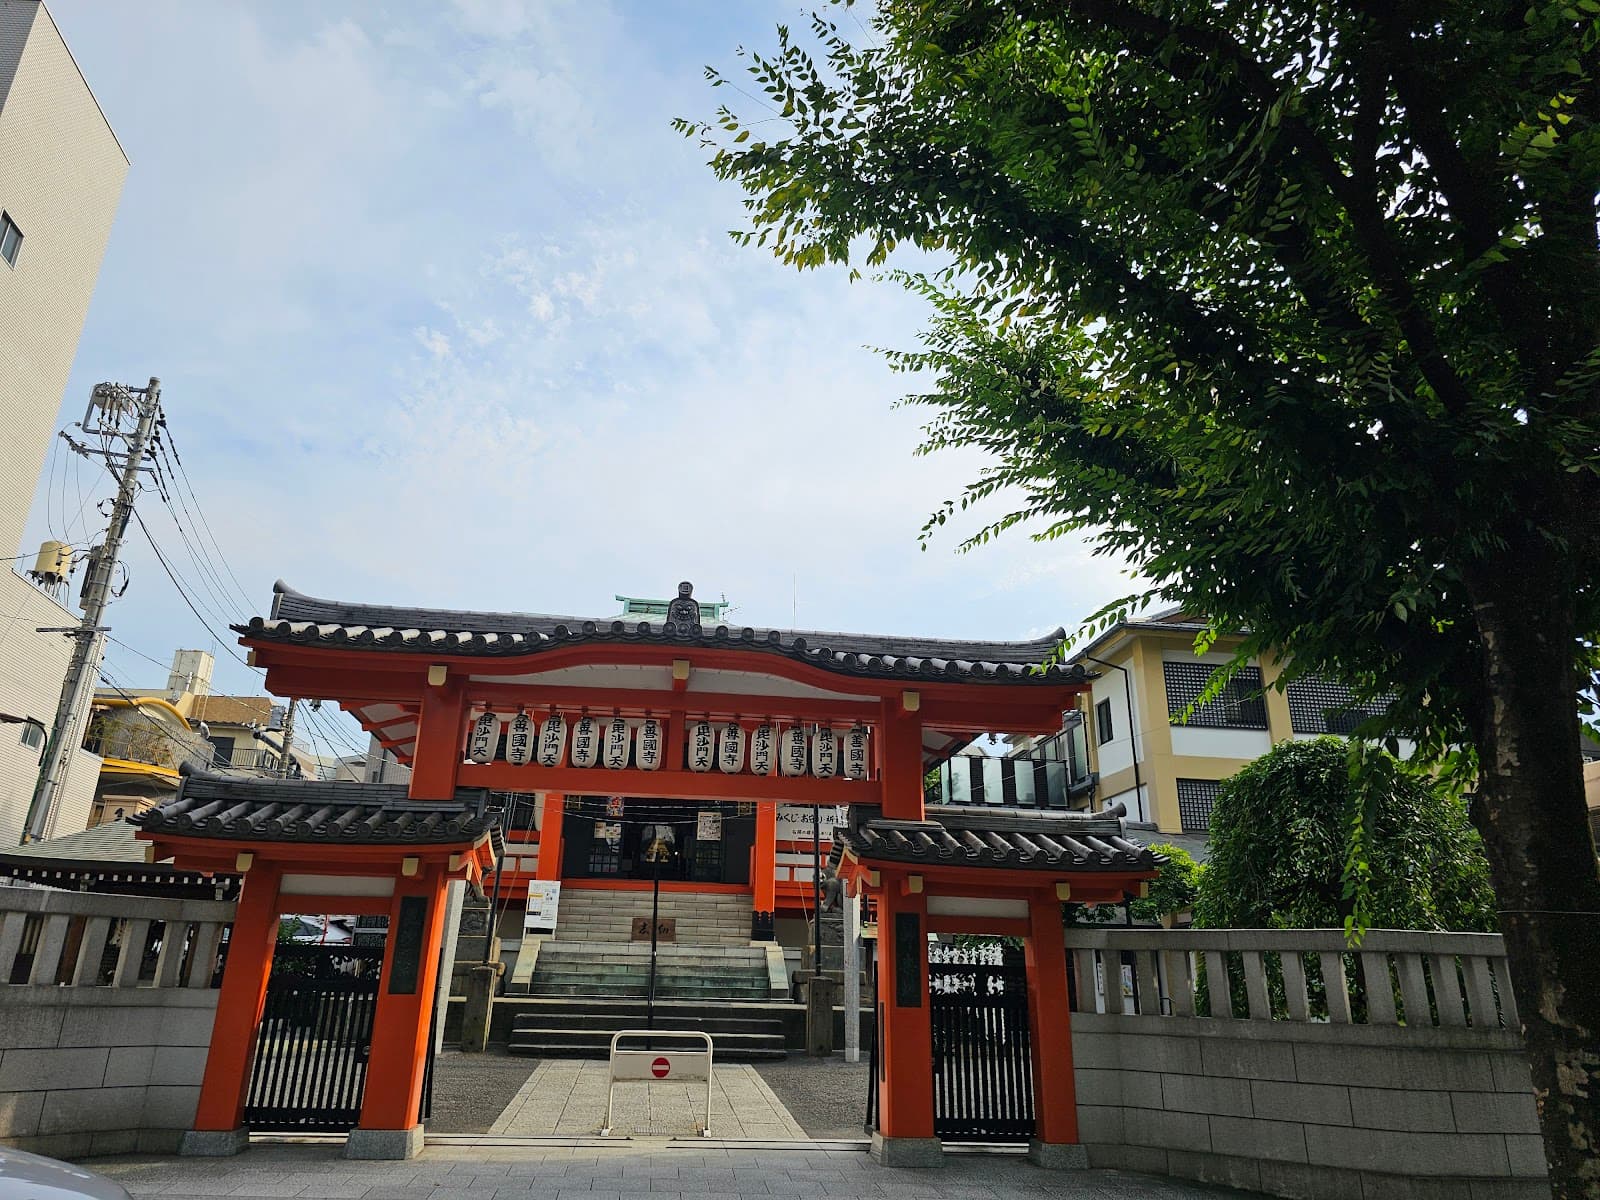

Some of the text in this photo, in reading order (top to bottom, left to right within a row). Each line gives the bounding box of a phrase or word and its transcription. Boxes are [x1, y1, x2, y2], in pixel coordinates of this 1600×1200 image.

[473, 716, 493, 757] 毘沙門天
[542, 718, 562, 764] 毘沙門天
[609, 721, 625, 766] 毘沙門天
[696, 724, 710, 767] 毘沙門天
[755, 727, 769, 771] 毘沙門天
[819, 730, 833, 774] 毘沙門天
